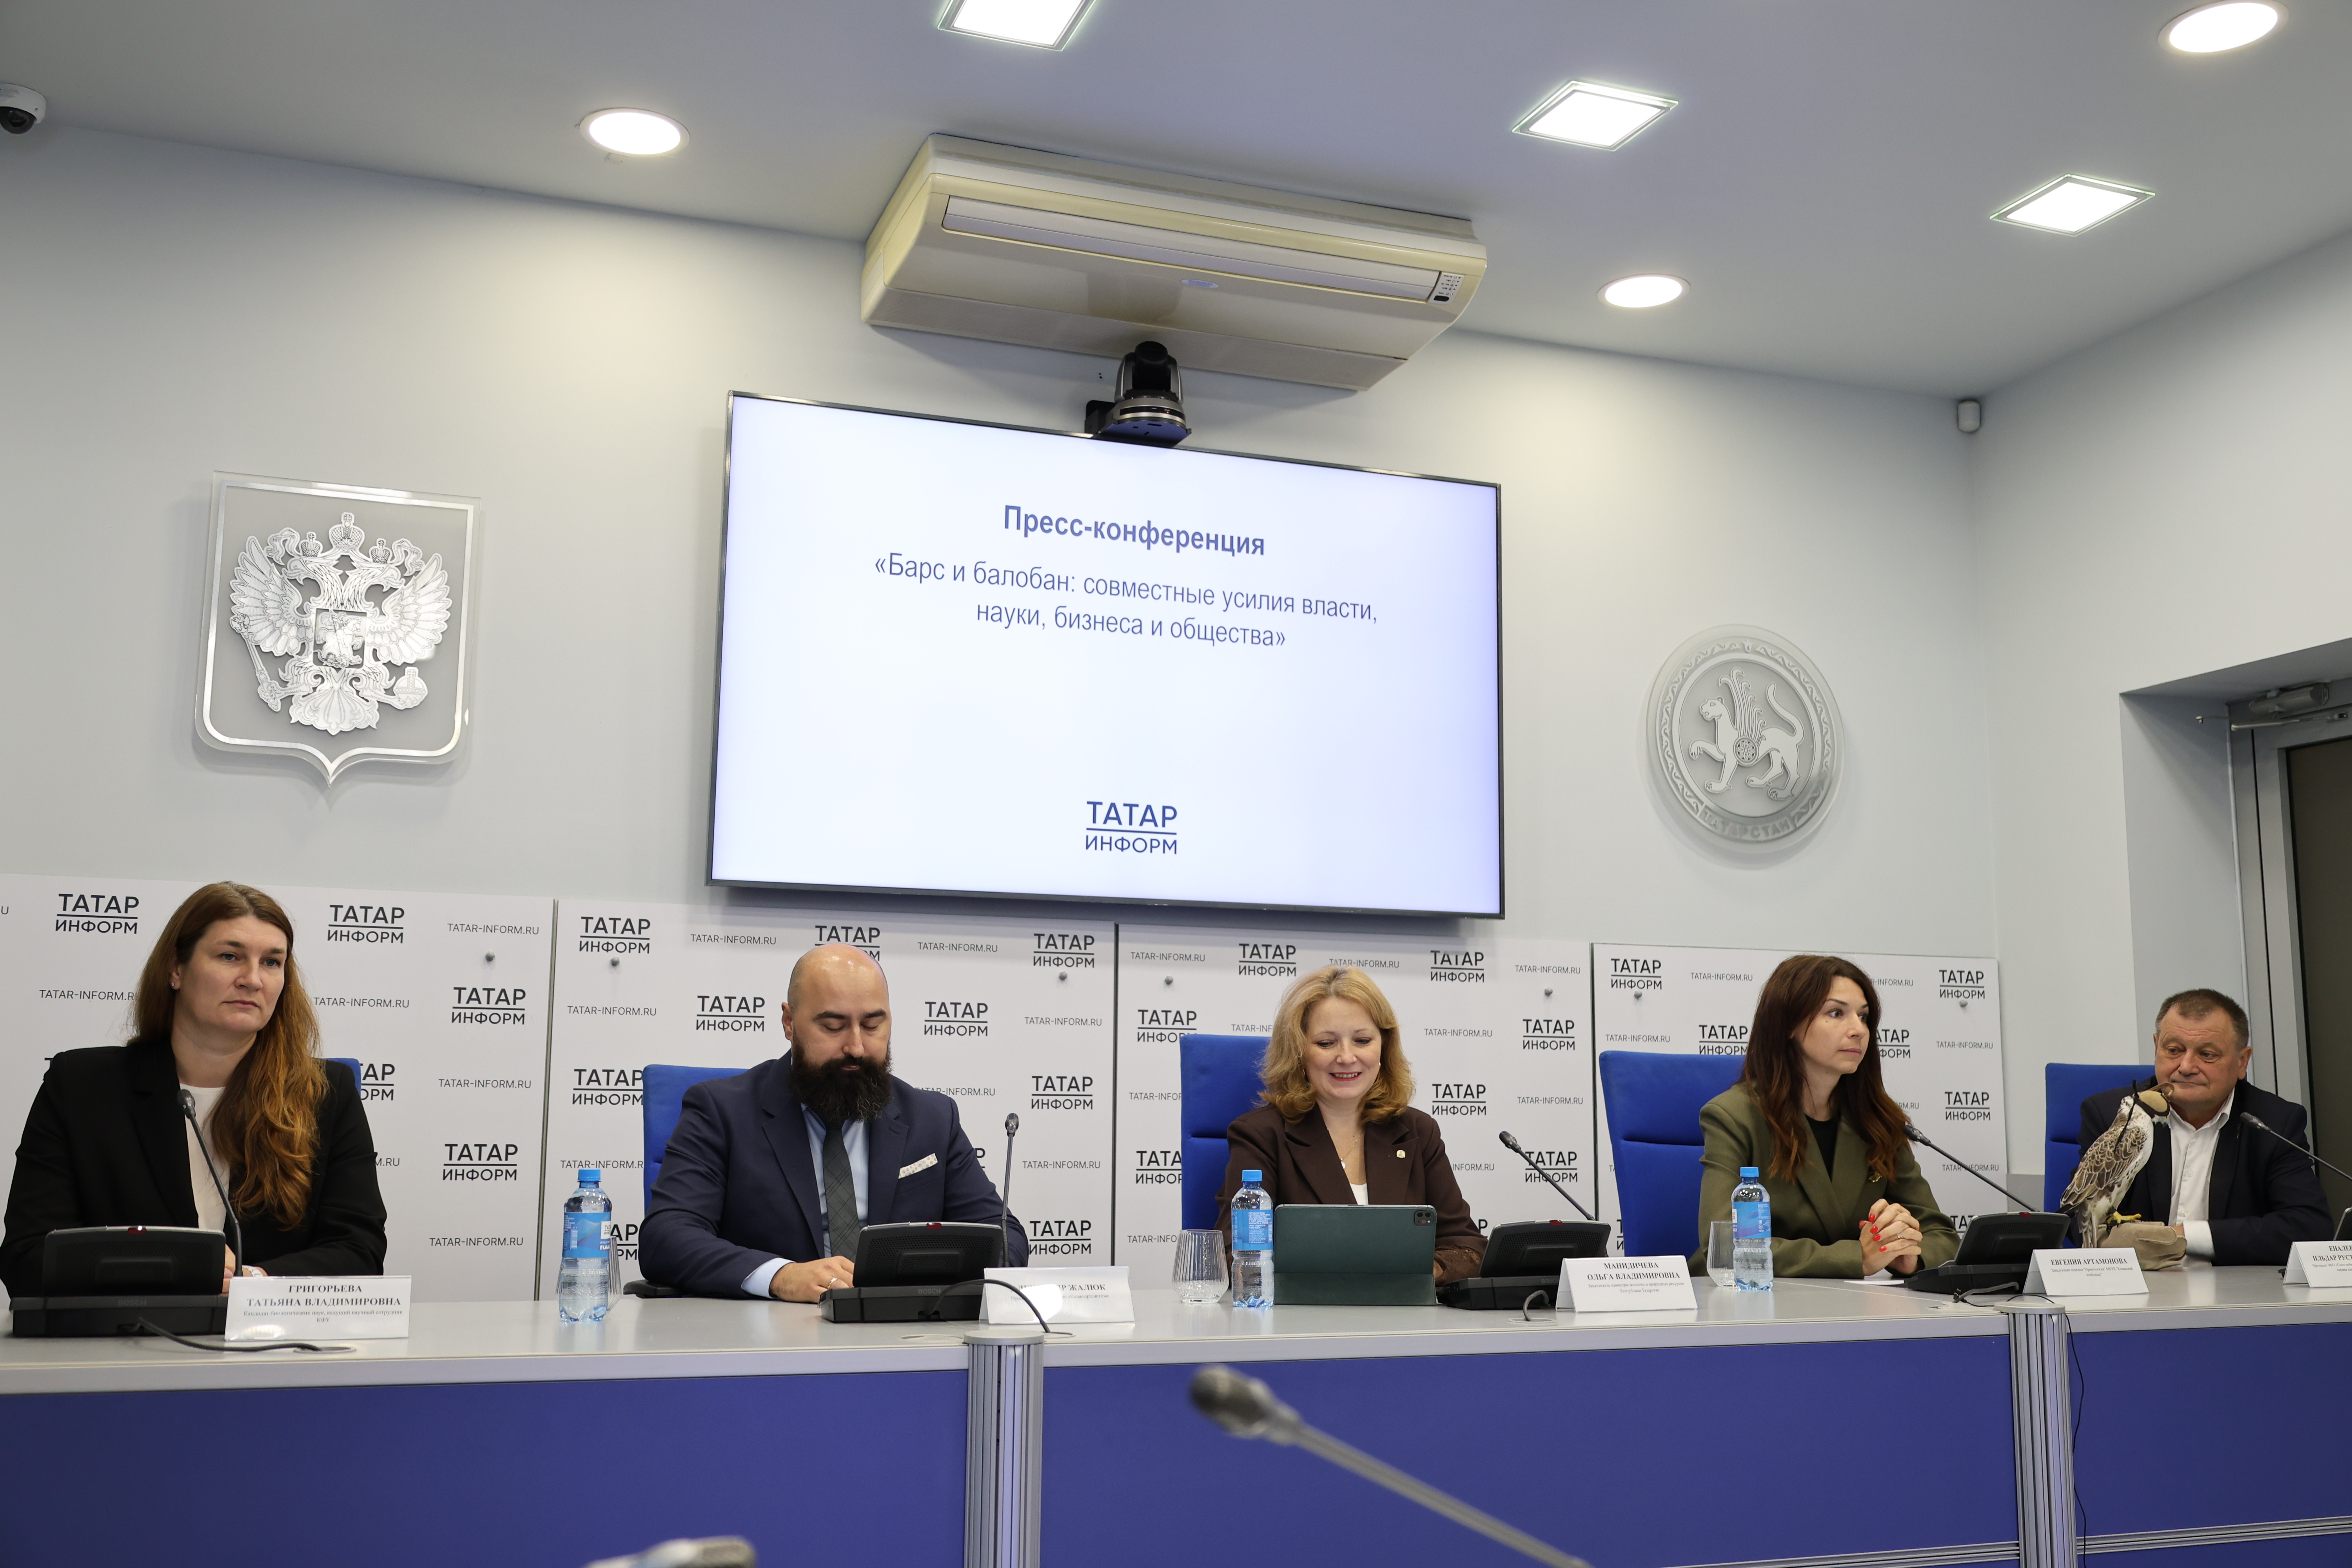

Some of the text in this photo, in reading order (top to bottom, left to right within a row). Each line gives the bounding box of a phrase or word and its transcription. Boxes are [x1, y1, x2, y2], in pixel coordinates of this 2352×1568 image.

[1005, 505, 1264, 557] Пресс-конференция
[875, 553, 1377, 624] «Барс и балобан: совместные усилия власти,
[978, 605, 1285, 646] науки, бизнеса и общества»
[1087, 801, 1177, 827] ТАТАР
[1086, 835, 1176, 854] ИНФОРМ
[59, 894, 139, 913] ТАТАР
[330, 905, 404, 924] ТАТАР
[56, 920, 137, 934] ИНФОРМ
[448, 924, 539, 935] TATAR-INFORM.RU
[581, 916, 650, 935] ТАТАР
[328, 930, 403, 943] ИНФОРМ
[691, 934, 776, 944] TATAR-INFORM.RU
[815, 926, 880, 943] ТАТАР
[579, 941, 650, 953] ИНФОРМ
[918, 942, 997, 952] TATAR-INFORM.RU
[1034, 933, 1094, 950] ТАТАР
[1131, 952, 1205, 962] TATAR-INFORM.RU
[1239, 944, 1296, 959] ТАТАР
[1034, 956, 1094, 968] ИНФОРМ
[1611, 959, 1661, 973] ТАТАР
[1239, 965, 1296, 976] ИНФОРМ
[1515, 965, 1580, 974] TATAR-INFORM.RU
[1431, 972, 1484, 982] ИНФОРМ
[1691, 973, 1752, 981] TATAR-INFORM.RU
[1939, 970, 1984, 984] ТАТАР
[1612, 979, 1662, 989] ИНФОРМ
[40, 990, 136, 1001] TATAR-INFORM.R
[454, 987, 526, 1005] ТАТАР
[1940, 989, 1985, 999] ИНФОРМ
[314, 998, 409, 1007] TATAR-INFORM.RU
[697, 996, 765, 1013] ТАТАР
[568, 1006, 656, 1016] TATAR-INFORM.RU
[925, 1002, 988, 1018] ТАТАР
[452, 1012, 524, 1024] ИНФОРМ
[1025, 1017, 1102, 1026] TATAR-INFORM.RU
[1138, 1009, 1196, 1025] ТАТАР
[696, 1020, 764, 1031] ИНФОРМ
[924, 1025, 987, 1036] ИНФОРМ
[1523, 1019, 1574, 1034] ТАТАР
[1137, 1032, 1185, 1043] ИНФО
[1425, 1029, 1492, 1037] TATAR-INFORM.RU
[1699, 1025, 1748, 1040] ТАТАР
[1877, 1029, 1909, 1043] АТАР
[1523, 1040, 1575, 1050] ИНФОРМ
[1880, 1049, 1911, 1058] ФОРМ
[439, 1079, 531, 1088] TATAR-INFORM.RU
[574, 1069, 643, 1086] ТАТАР
[1032, 1076, 1093, 1091] ТАТАР
[1432, 1084, 1486, 1098] ТАТАР
[572, 1093, 643, 1105] ИНФОРМ
[1032, 1099, 1093, 1109] ИНФОРМ
[1945, 1092, 1989, 1105] ТАТАР
[1432, 1105, 1486, 1115] ИНФОРМ
[1945, 1111, 1990, 1120] ИНФОРМ
[445, 1144, 518, 1161] ТАТАР
[1136, 1151, 1181, 1166] ТАТА
[1525, 1151, 1577, 1166] ТАТАР
[561, 1160, 643, 1169] TATAR-INFORM.R
[443, 1169, 517, 1180] ИНФОРМ
[1030, 1220, 1091, 1236] ТАТАР
[430, 1238, 523, 1246] TATAR-INFORM.RU
[1029, 1243, 1091, 1254] ИНФОРМ
[1616, 1272, 1681, 1281] ВЛАДИМИРОВНА
[289, 1285, 362, 1293] ГРИГОРЬЕВА
[247, 1298, 401, 1307] ТАТЬЯНА ВЛАДИМИРОВНА
